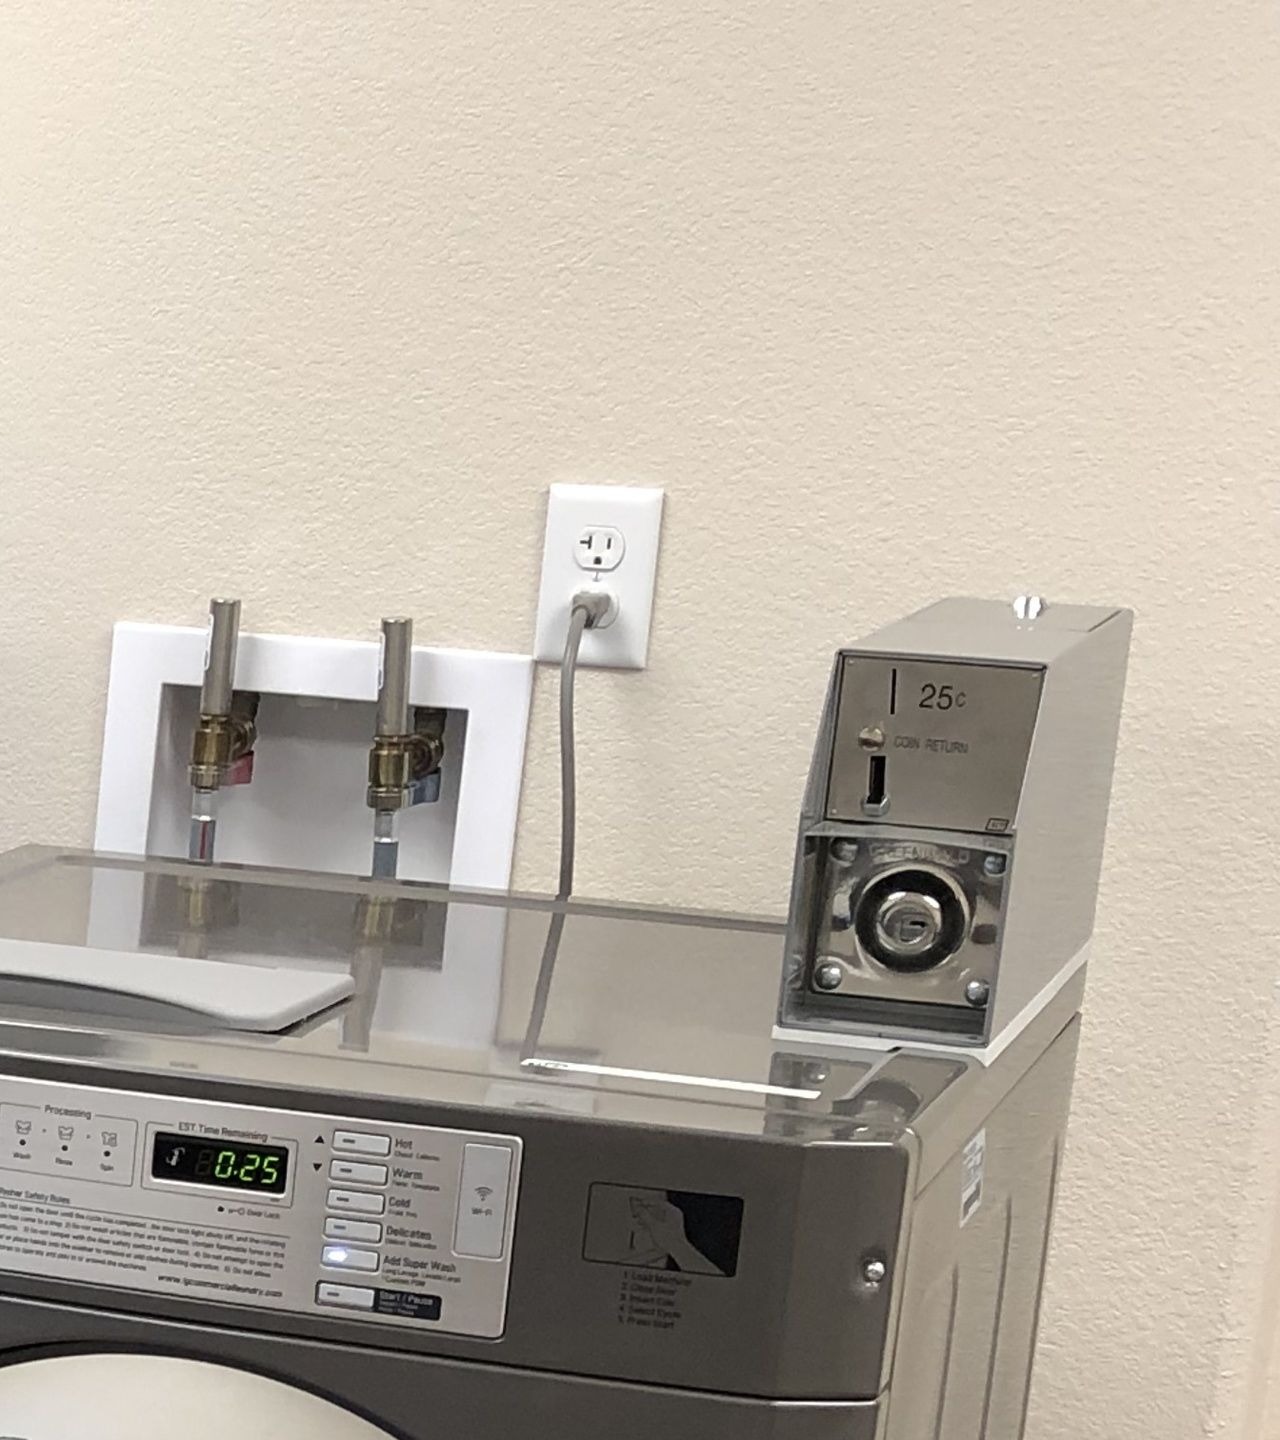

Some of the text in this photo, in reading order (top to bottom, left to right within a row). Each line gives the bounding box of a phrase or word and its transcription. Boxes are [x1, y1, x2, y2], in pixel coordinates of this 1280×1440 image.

[894, 735, 969, 754] COIN RETURN
[44, 1104, 91, 1120] Processing
[199, 1123, 219, 1136] Time
[222, 1127, 268, 1143] Remaining
[395, 1138, 413, 1150] Hot
[391, 1166, 423, 1180] Warm
[388, 1196, 411, 1209] Cold
[386, 1225, 432, 1241] Delicates
[383, 1255, 457, 1273] Add Super Wash
